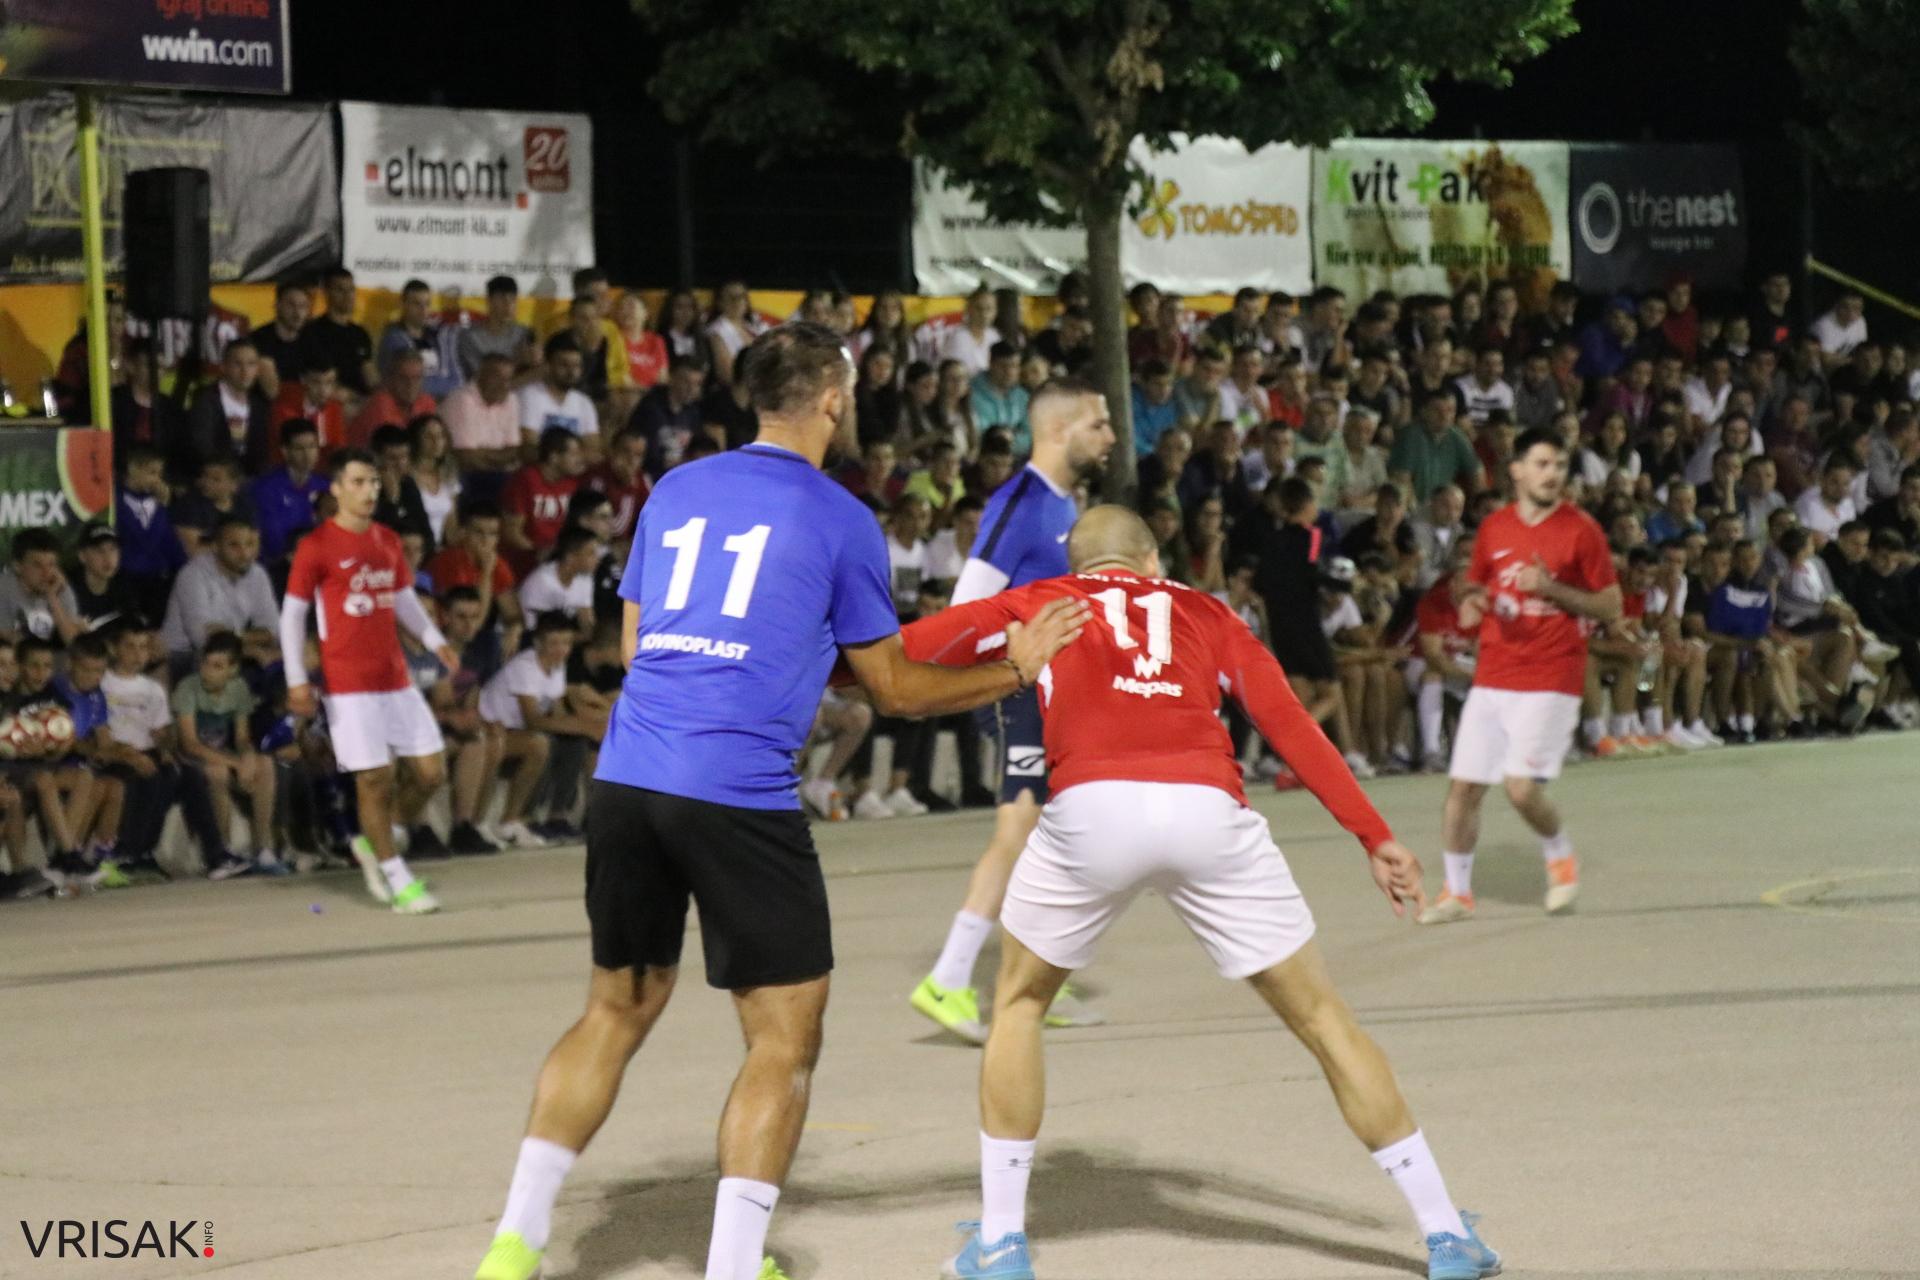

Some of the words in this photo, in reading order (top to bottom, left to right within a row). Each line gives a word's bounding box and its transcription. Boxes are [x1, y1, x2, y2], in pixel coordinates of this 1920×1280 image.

[142, 27, 273, 67] wwin.com
[386, 146, 511, 200] elmont
[1327, 157, 1399, 203] Kvit
[662, 517, 772, 619] 11
[1088, 587, 1173, 664] 11
[1112, 675, 1183, 698] Mepas
